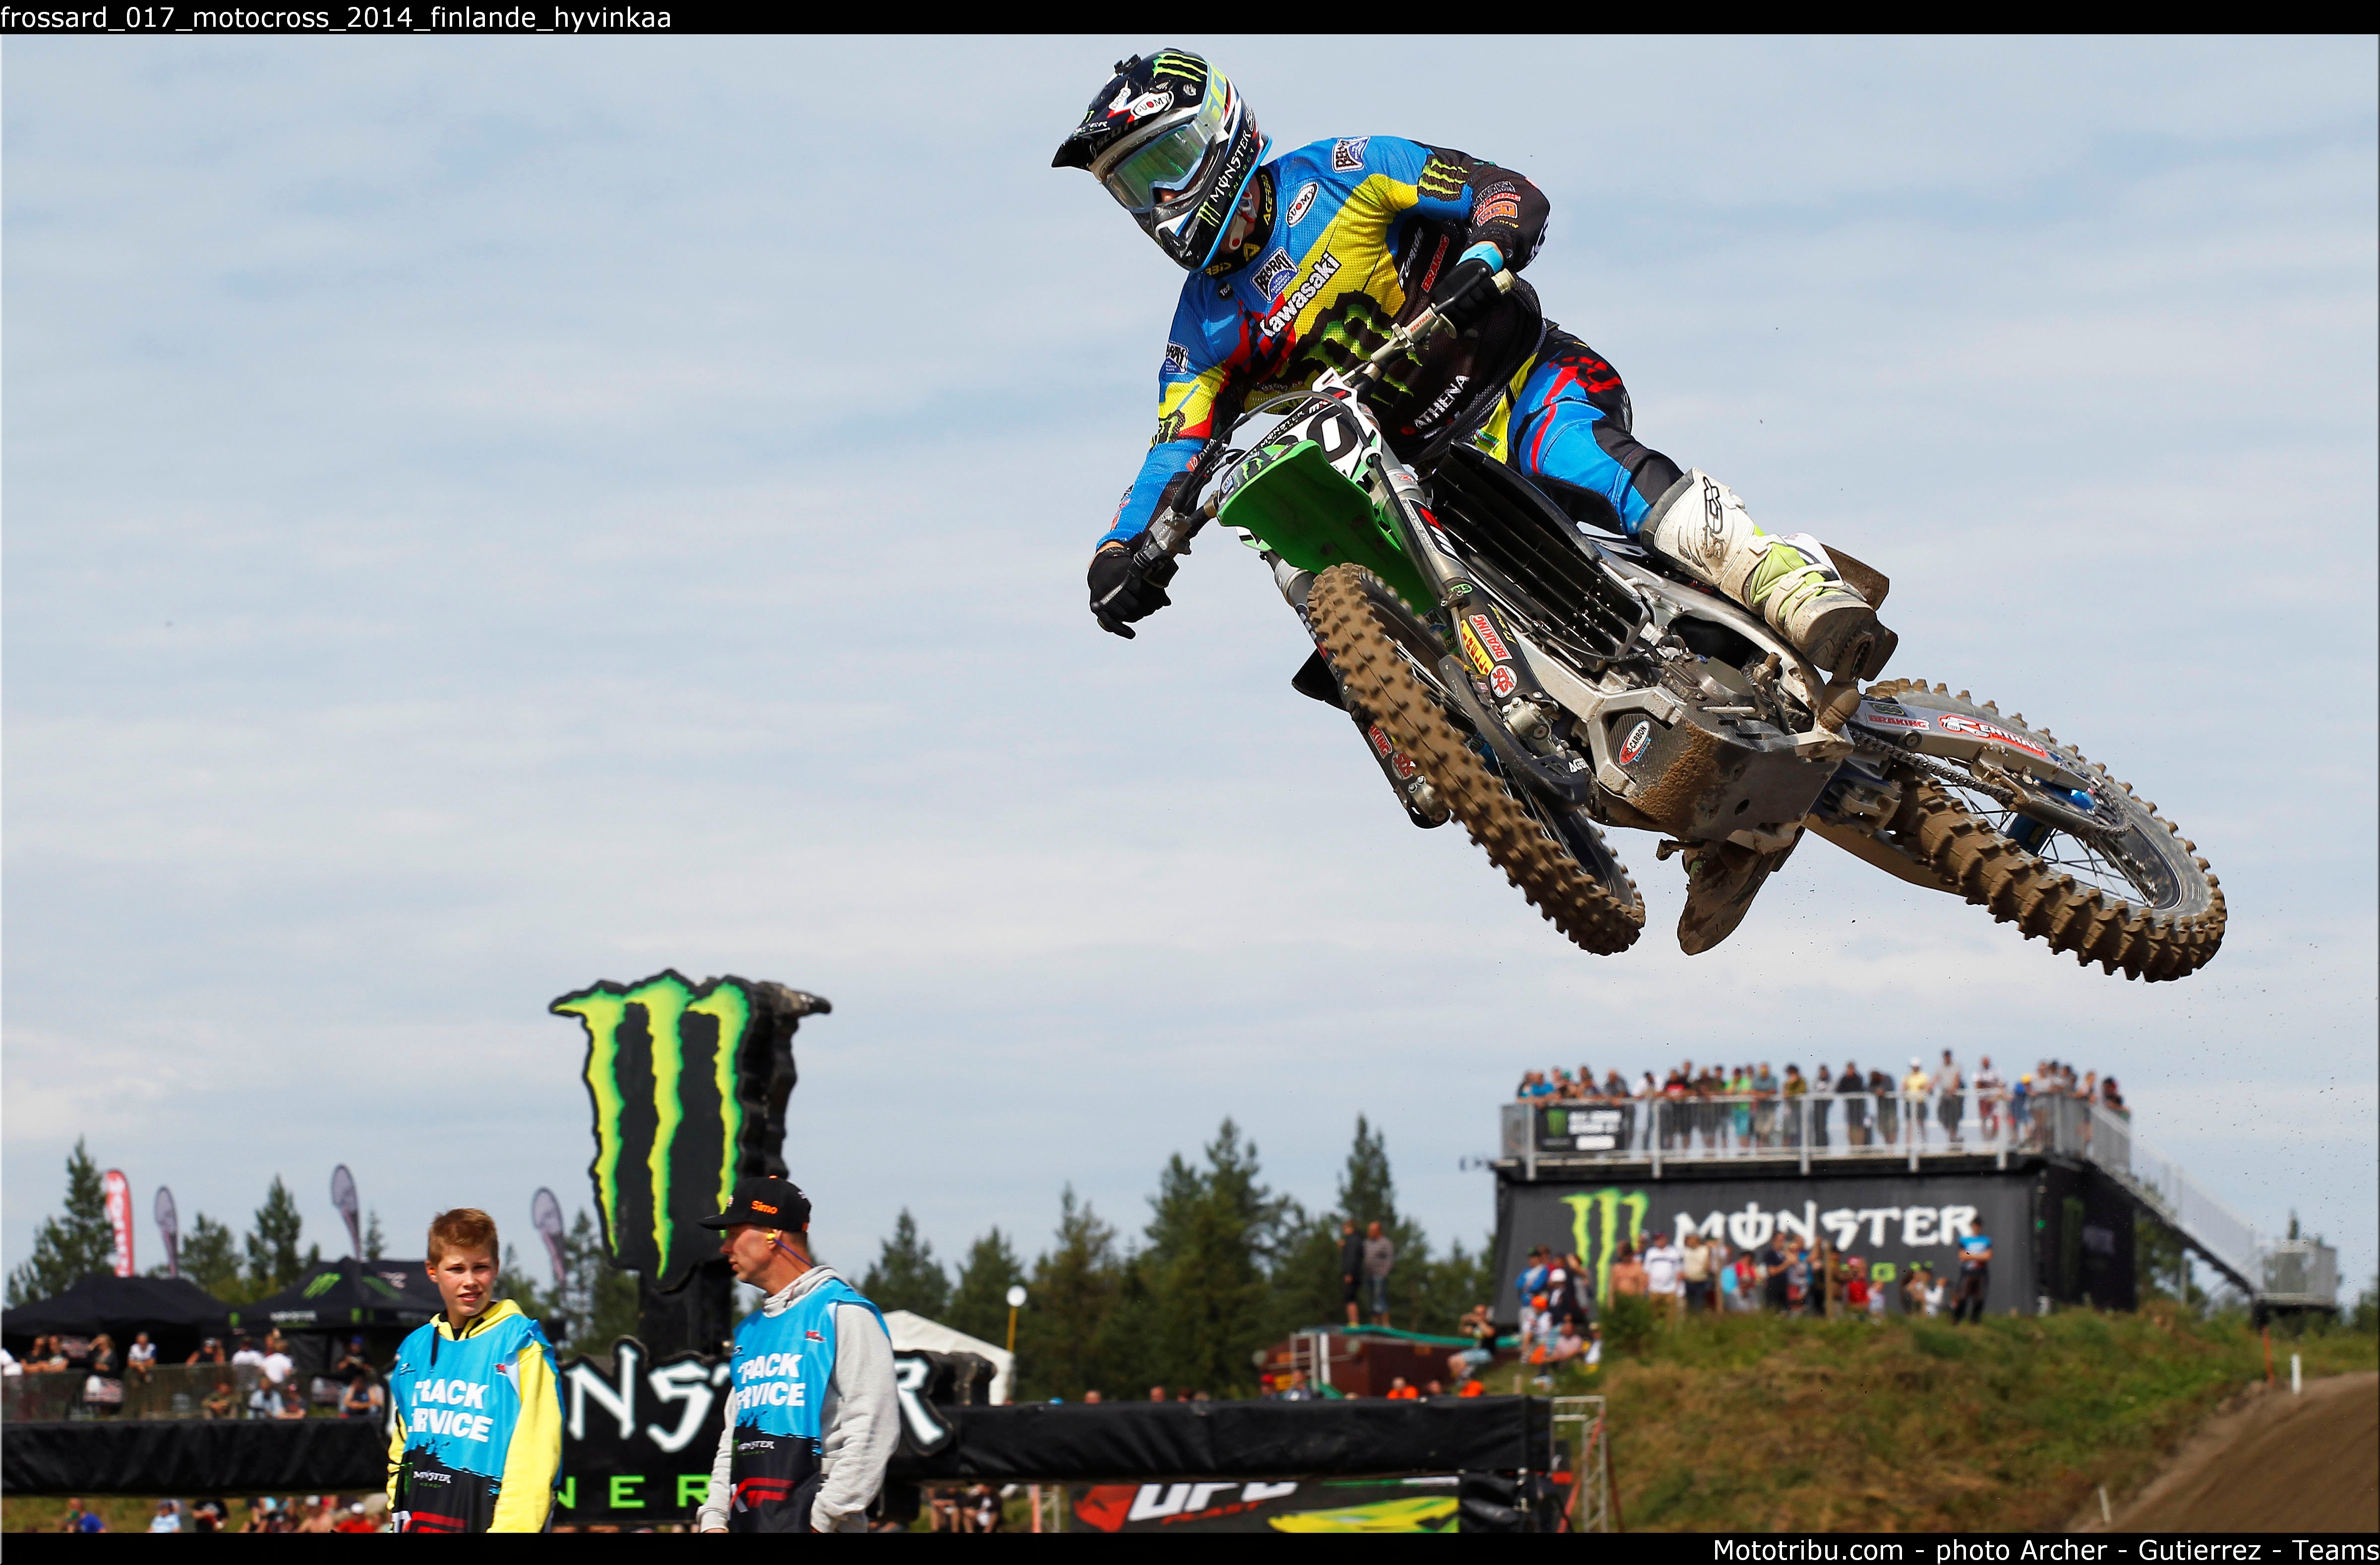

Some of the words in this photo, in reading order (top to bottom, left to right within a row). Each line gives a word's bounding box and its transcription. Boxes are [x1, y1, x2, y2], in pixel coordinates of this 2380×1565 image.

[1133, 94, 1170, 113] SUOMY
[1210, 130, 1251, 202] MONSTER
[1288, 187, 1314, 222] SUOMY
[1422, 234, 1449, 293] BRAKING
[1260, 252, 1342, 337] Kawasaki
[1410, 312, 1432, 333] RENTHAL
[1415, 375, 1470, 429] ATHENA
[1260, 411, 1305, 448] MONSTER
[1461, 623, 1489, 673] IRELLI
[1472, 615, 1508, 659] BRAKING
[1869, 714, 1928, 730] BRAKING
[1622, 725, 1647, 760] PRO-CARBON
[751, 1201, 778, 1214] Simo
[1674, 1200, 1978, 1253] MONSTER
